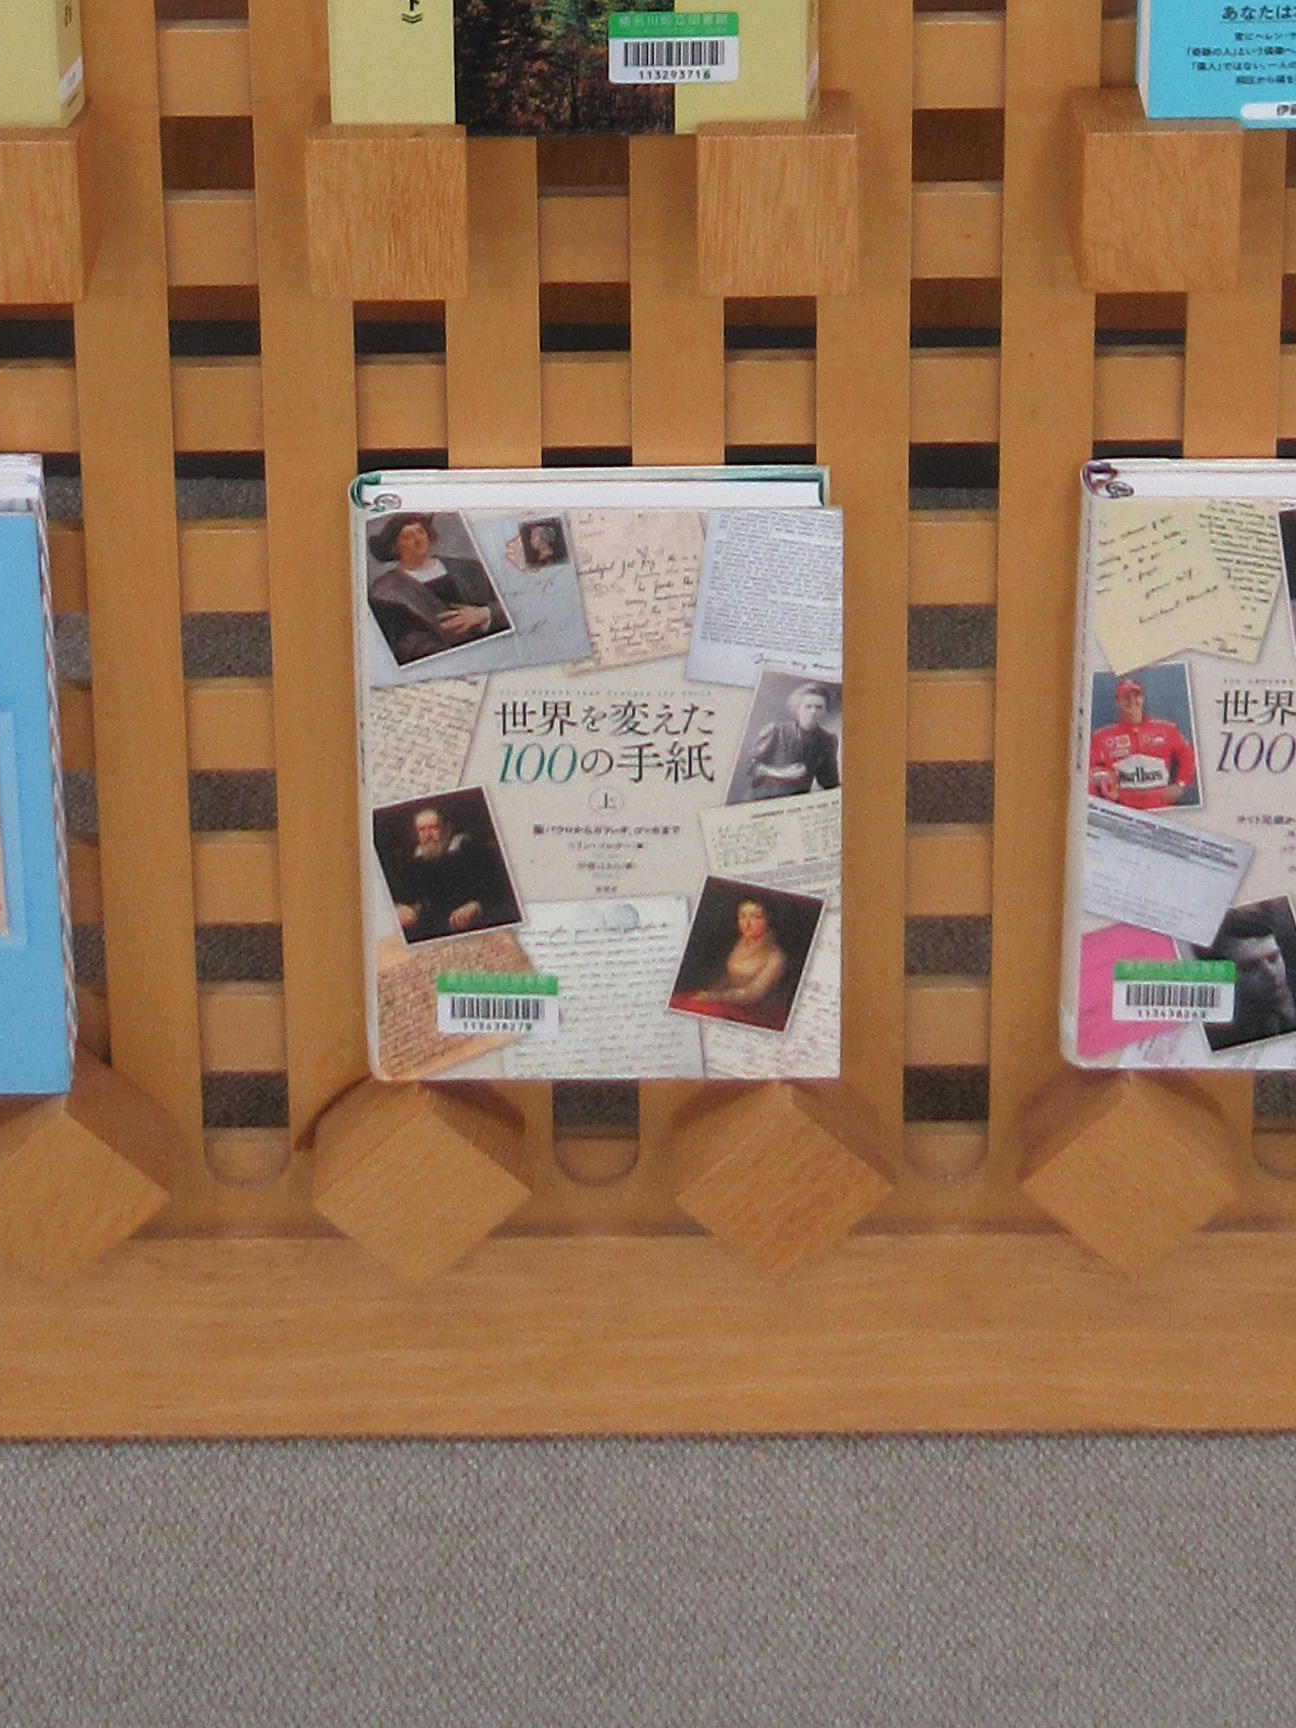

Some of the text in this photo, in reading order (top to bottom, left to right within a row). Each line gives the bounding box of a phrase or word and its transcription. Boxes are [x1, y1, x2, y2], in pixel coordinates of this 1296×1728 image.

[639, 69, 711, 80] 113293716
[494, 699, 716, 736] 世界を変えた
[499, 740, 716, 784] 100の手紙
